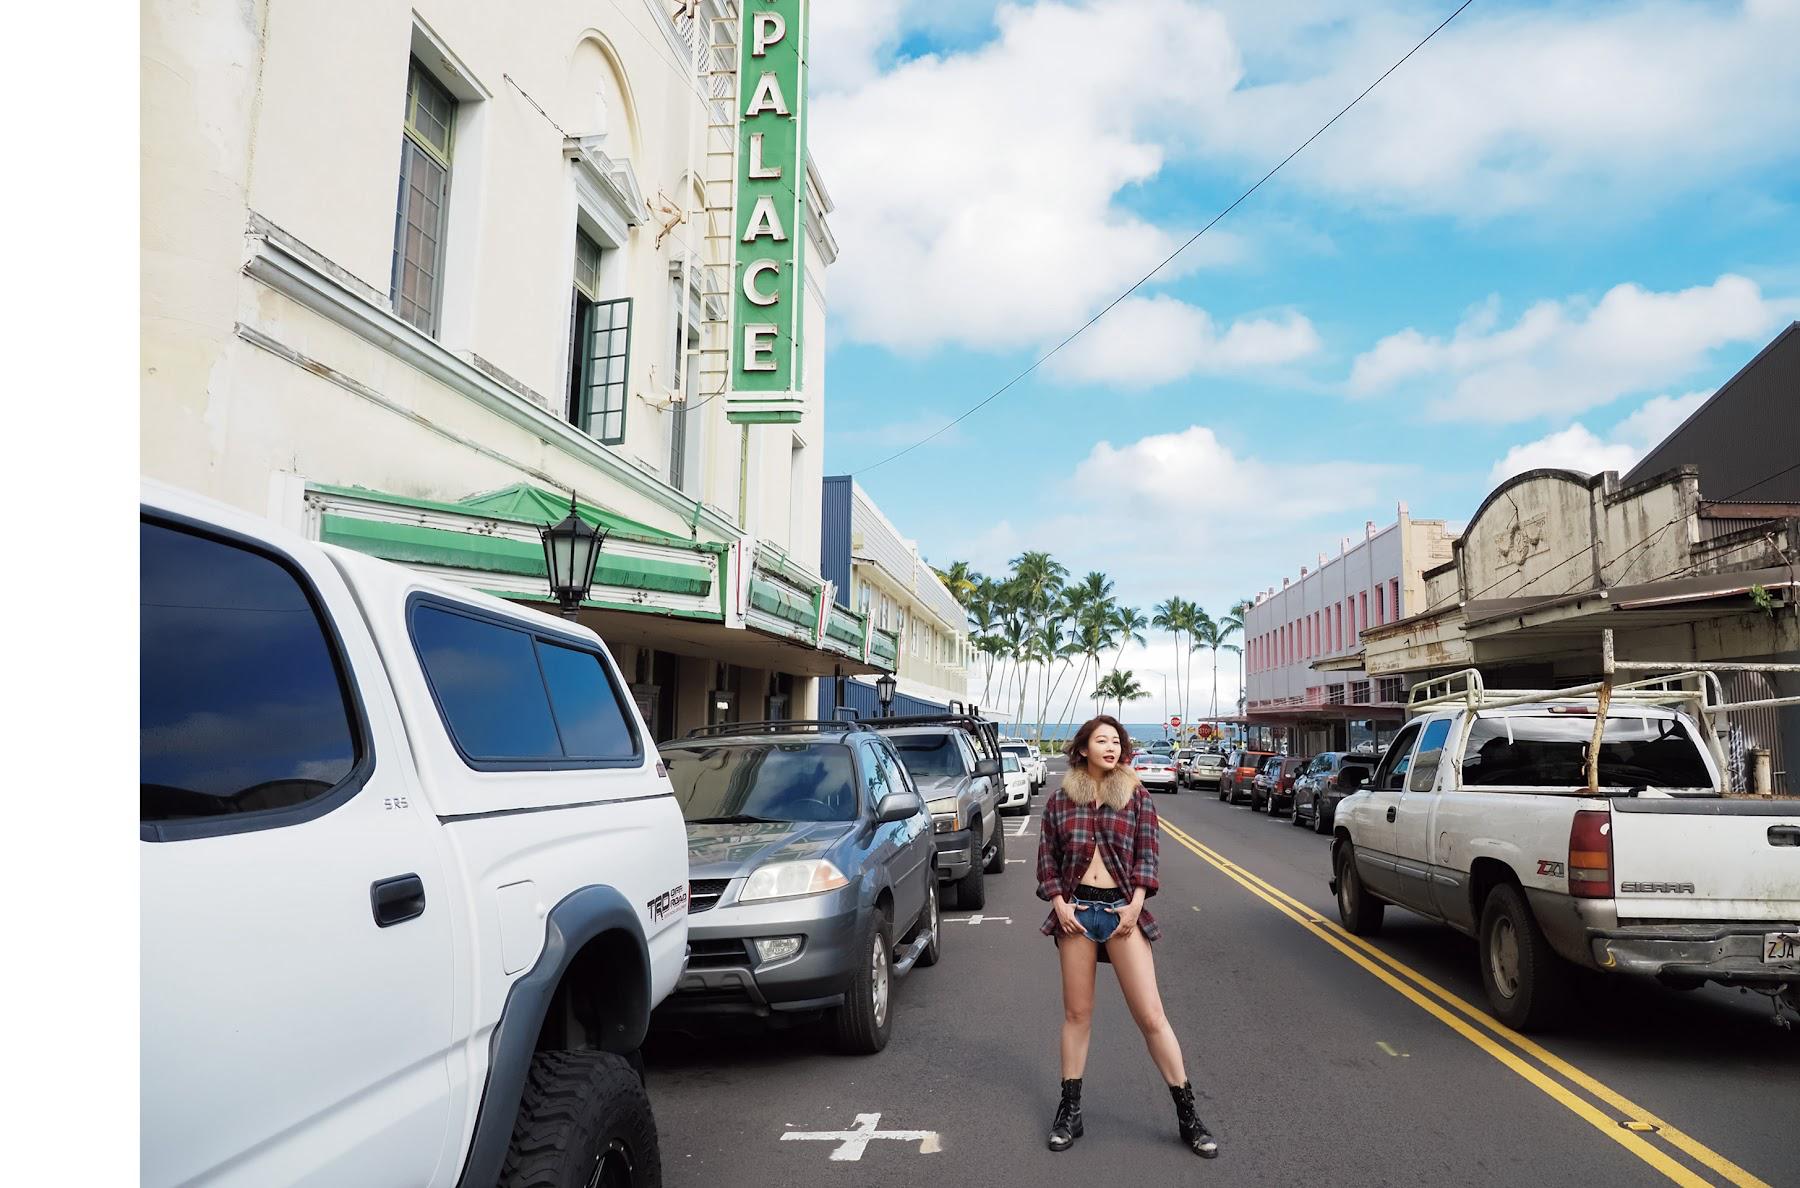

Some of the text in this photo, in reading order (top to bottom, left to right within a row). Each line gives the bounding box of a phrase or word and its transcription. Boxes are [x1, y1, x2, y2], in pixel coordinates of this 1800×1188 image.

[741, 11, 791, 372] PALACE
[1621, 881, 1695, 894] SIERRA
[647, 891, 670, 922] TRD
[670, 893, 687, 906] ROAD
[1768, 941, 1794, 958] ZJA
